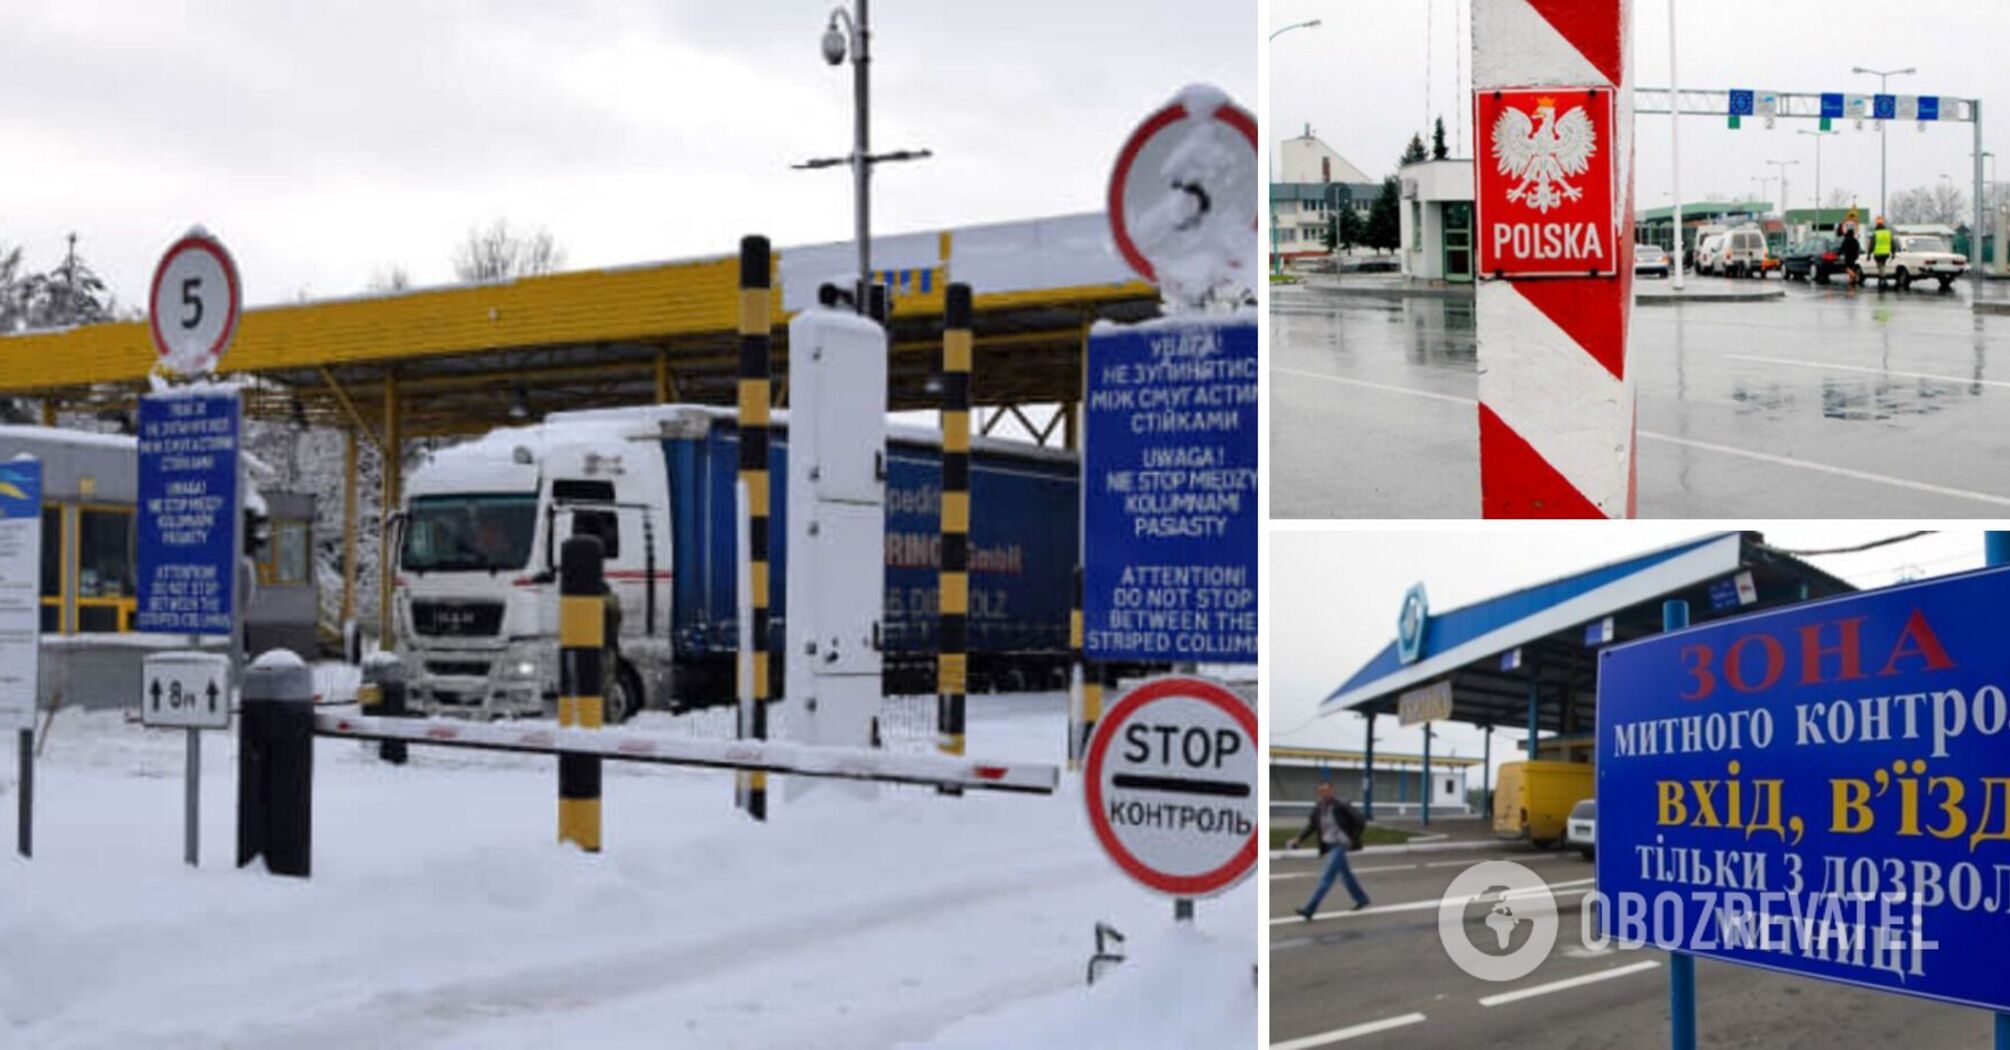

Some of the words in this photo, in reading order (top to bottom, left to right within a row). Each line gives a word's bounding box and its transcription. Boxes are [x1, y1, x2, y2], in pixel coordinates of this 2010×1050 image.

[1494, 223, 1603, 259] POLSKA
[180, 277, 203, 330] 5
[1103, 364, 1131, 384] НЕ
[1132, 409, 1238, 433] СТІЙКАМИ
[1138, 470, 1185, 491] STOP
[1122, 566, 1245, 586] ATTENTION!
[1114, 588, 1142, 607] DO
[1147, 588, 1189, 607] NOT
[1197, 588, 1252, 608] STOP
[1110, 610, 1208, 630] BETWEEN
[1214, 611, 1257, 631] THE
[1680, 608, 1958, 702] ЗОНА
[1614, 707, 1774, 757] митного
[1796, 684, 2010, 758] контро
[1124, 723, 1241, 768] STOP
[1111, 800, 1251, 836] КОНТРОЛЬ
[1656, 759, 1805, 846] вхід,
[1636, 834, 1767, 891] тільки
[1783, 853, 1804, 897] з
